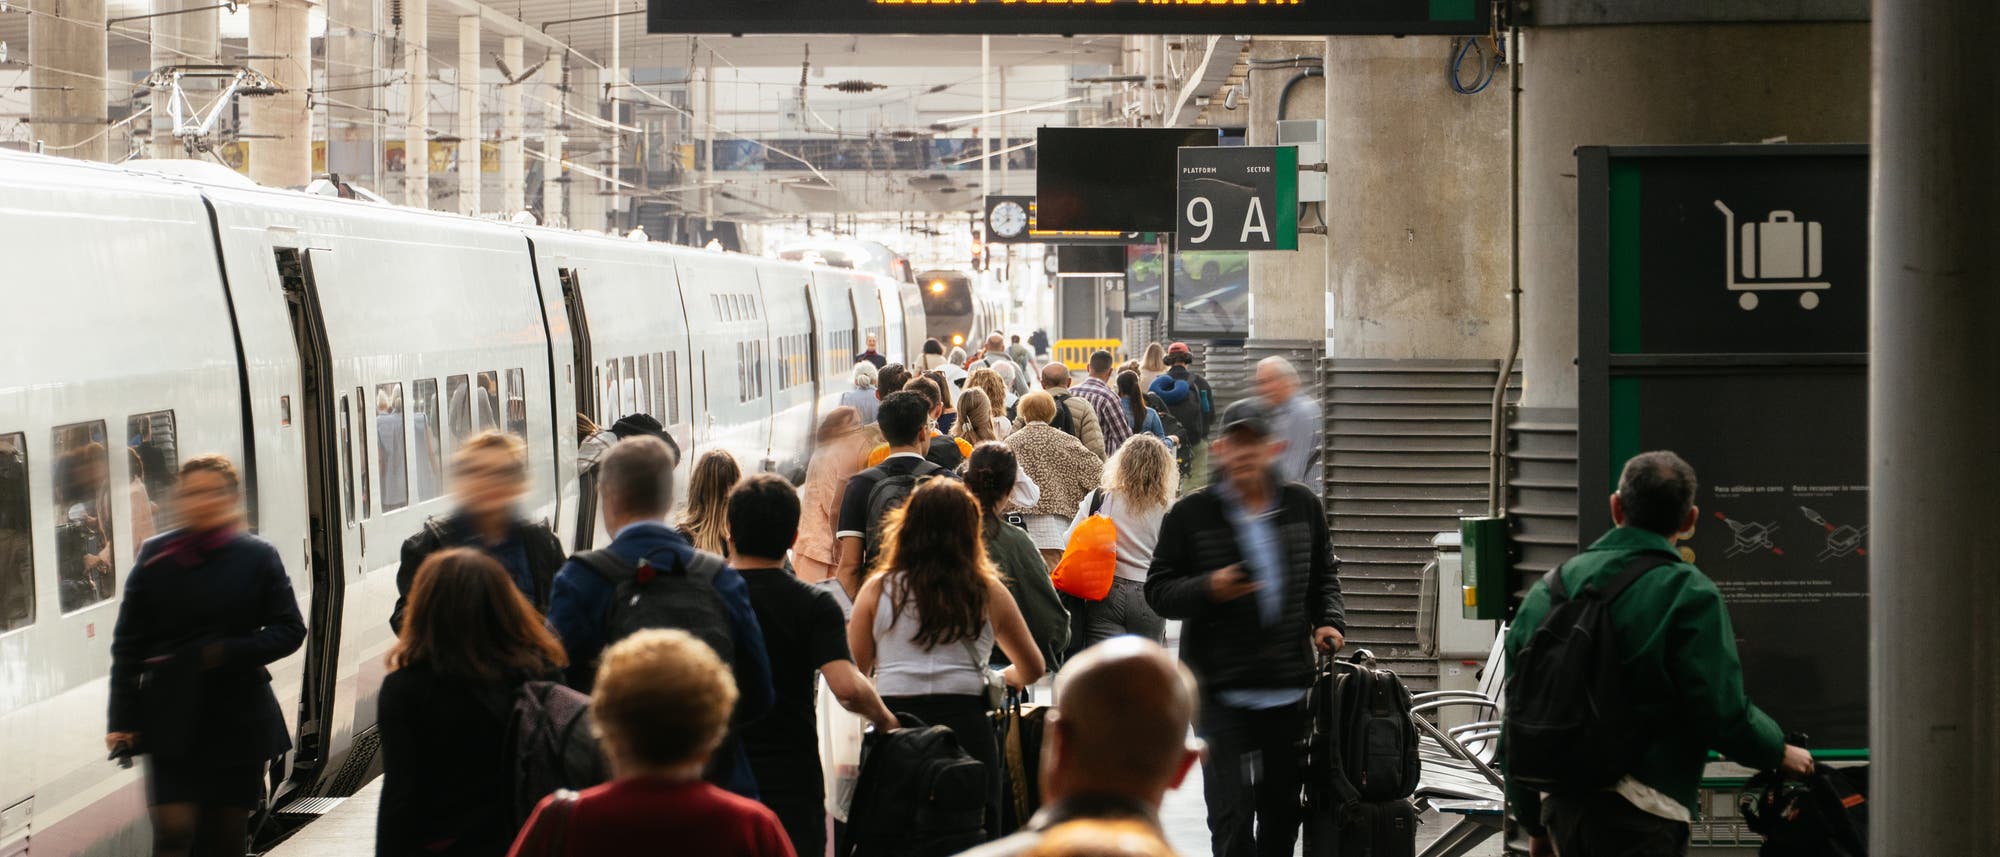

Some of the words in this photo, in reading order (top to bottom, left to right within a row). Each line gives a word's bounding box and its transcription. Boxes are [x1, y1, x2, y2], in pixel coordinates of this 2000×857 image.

[1186, 196, 1214, 244] 9
[1240, 196, 1271, 243] A
[1105, 279, 1114, 291] 9
